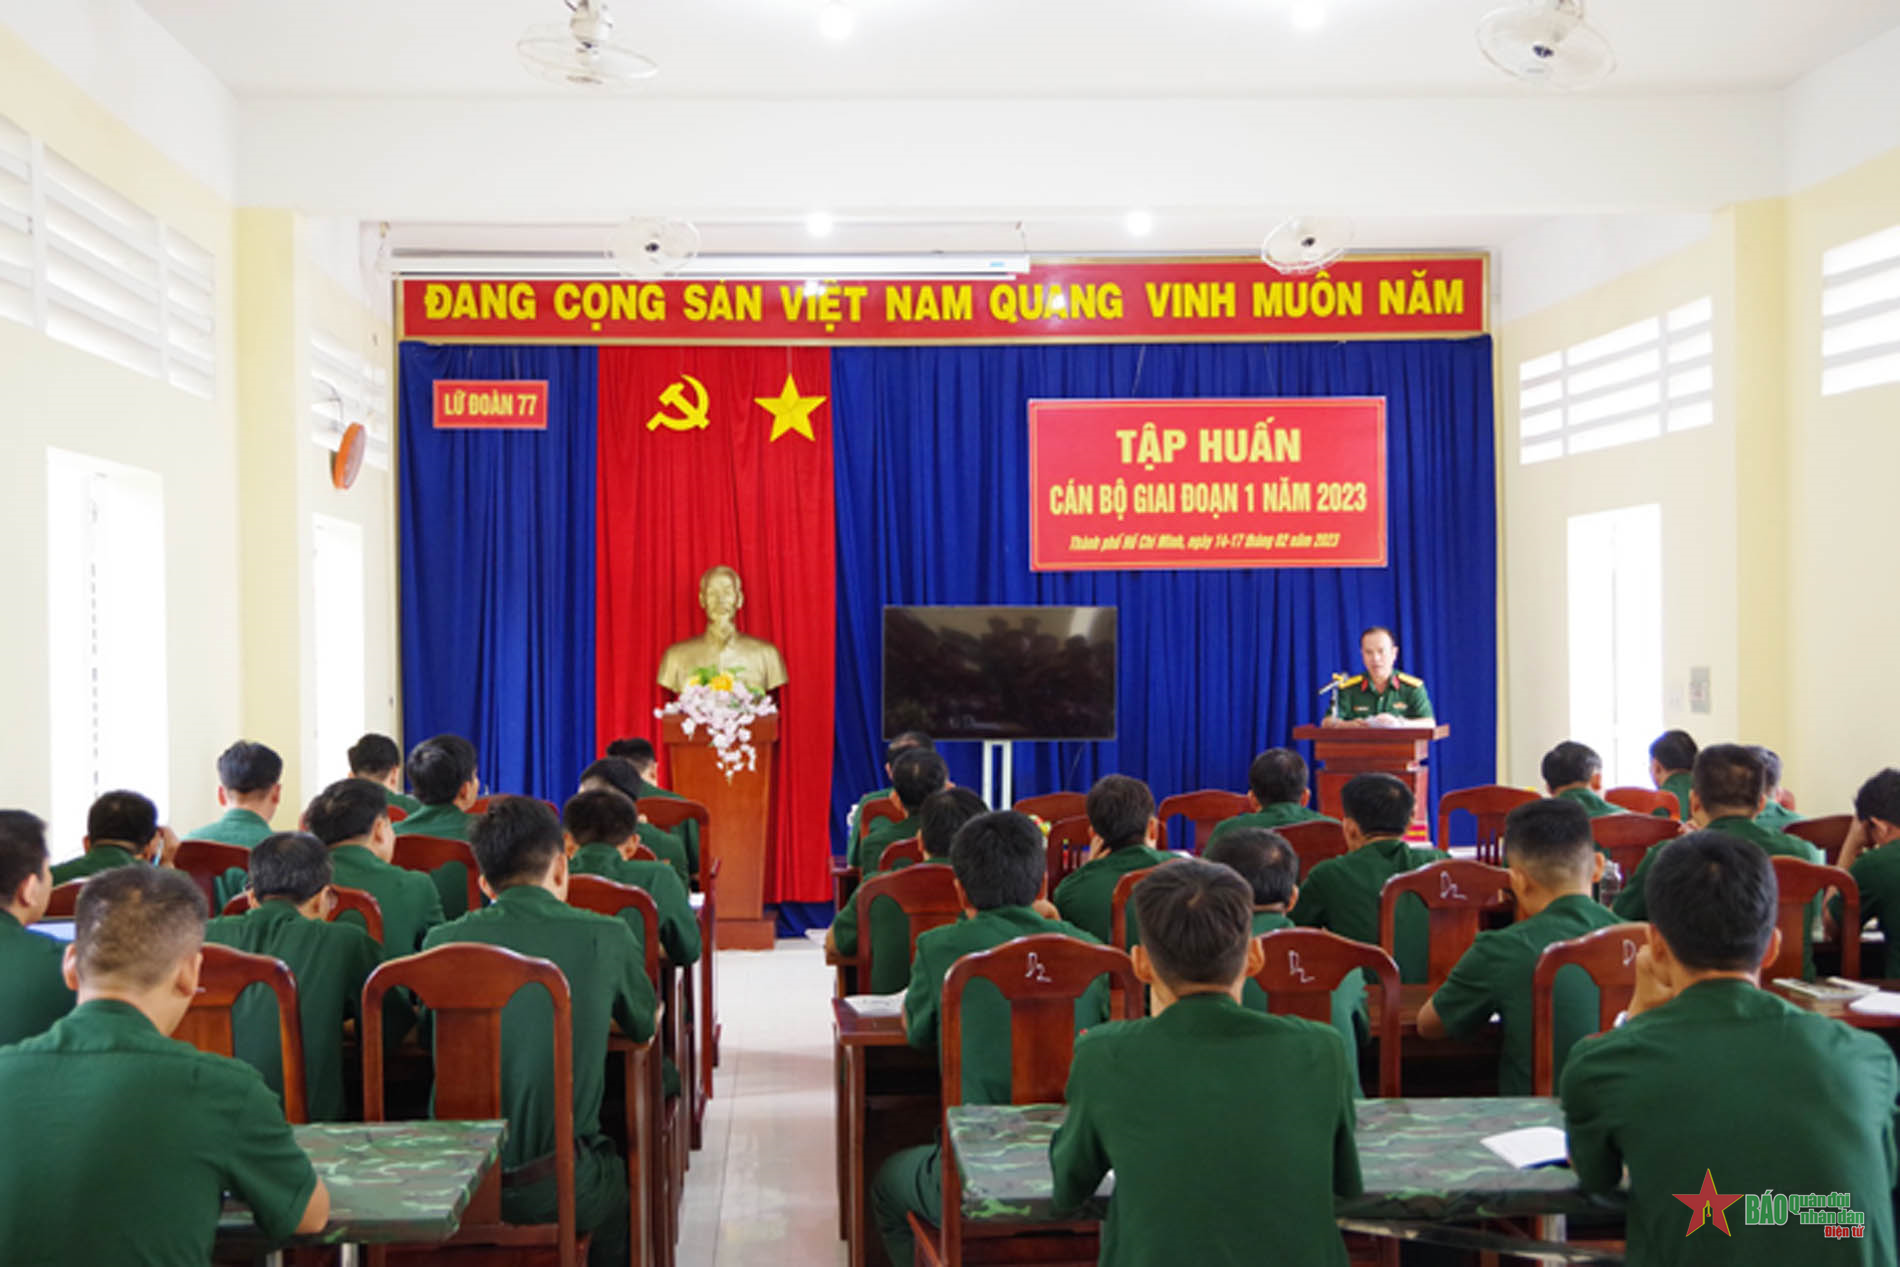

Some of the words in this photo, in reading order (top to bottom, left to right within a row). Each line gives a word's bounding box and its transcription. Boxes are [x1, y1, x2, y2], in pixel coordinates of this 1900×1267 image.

[886, 286, 972, 321] NAM
[989, 283, 1123, 323] QUANG
[1146, 282, 1235, 318] VINH
[1253, 271, 1363, 317] MUÔN
[1380, 270, 1464, 316] NĂM
[444, 389, 466, 415] LỮ
[469, 389, 513, 415] ĐOÀN
[518, 394, 537, 415] 77
[1116, 422, 1187, 471] TẬP
[1200, 416, 1300, 463] HUẤN
[1050, 479, 1093, 515] CÁN
[1100, 478, 1127, 520] BỘ
[1134, 484, 1175, 513] GIAI
[1181, 484, 1238, 518] ĐOẠN
[1245, 484, 1254, 512] 1
[1263, 477, 1311, 512] NĂM
[1317, 483, 1367, 511] 2023
